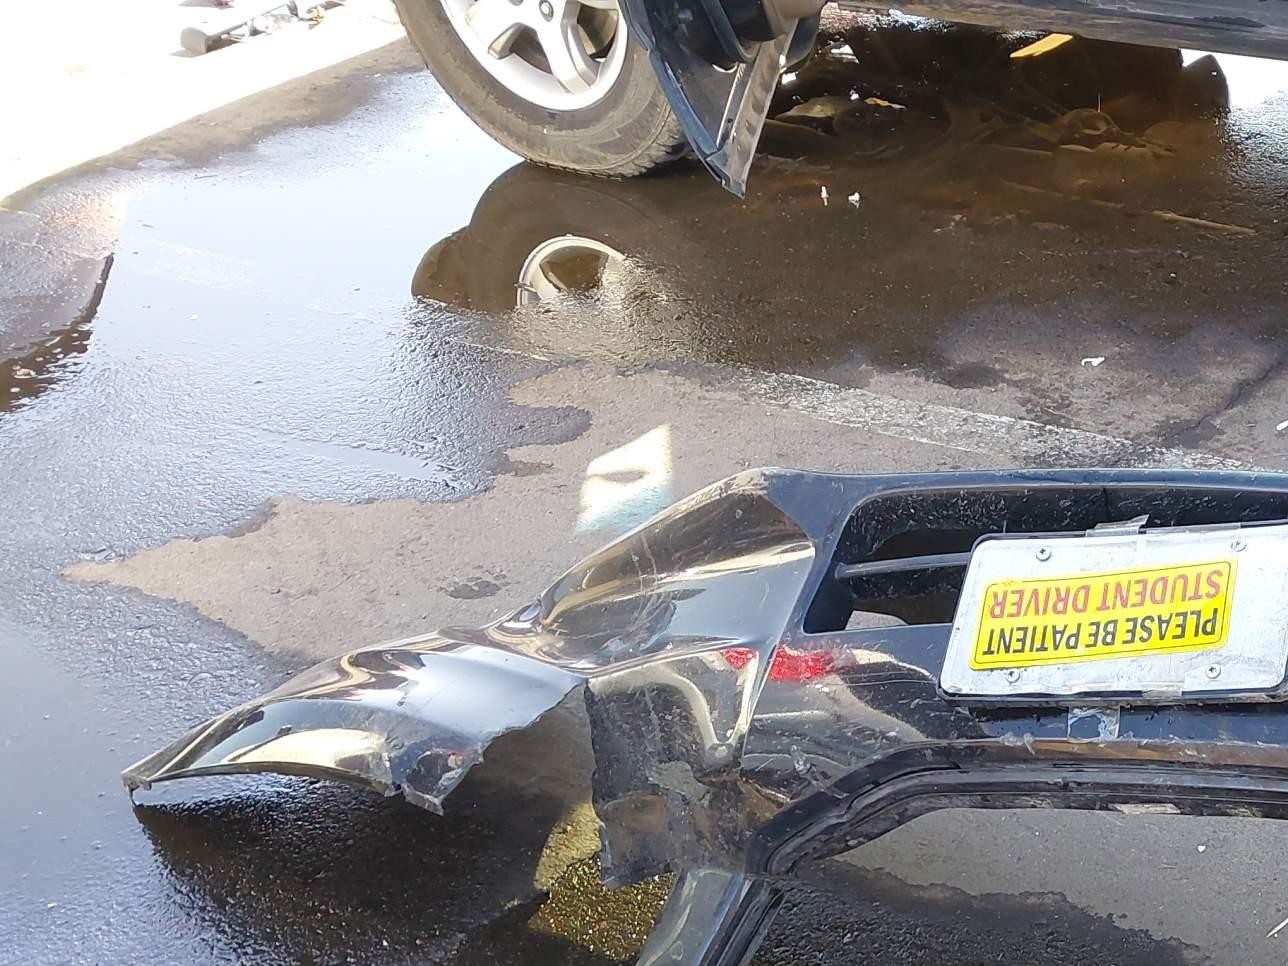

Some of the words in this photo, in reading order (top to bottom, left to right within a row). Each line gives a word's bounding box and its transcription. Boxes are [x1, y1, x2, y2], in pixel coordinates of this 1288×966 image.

[989, 584, 1090, 619] DRIVER
[1096, 570, 1223, 611] STUDENT
[982, 622, 1082, 655] PATIENT
[1085, 618, 1120, 648] BE
[1122, 607, 1219, 645] PLEASE
